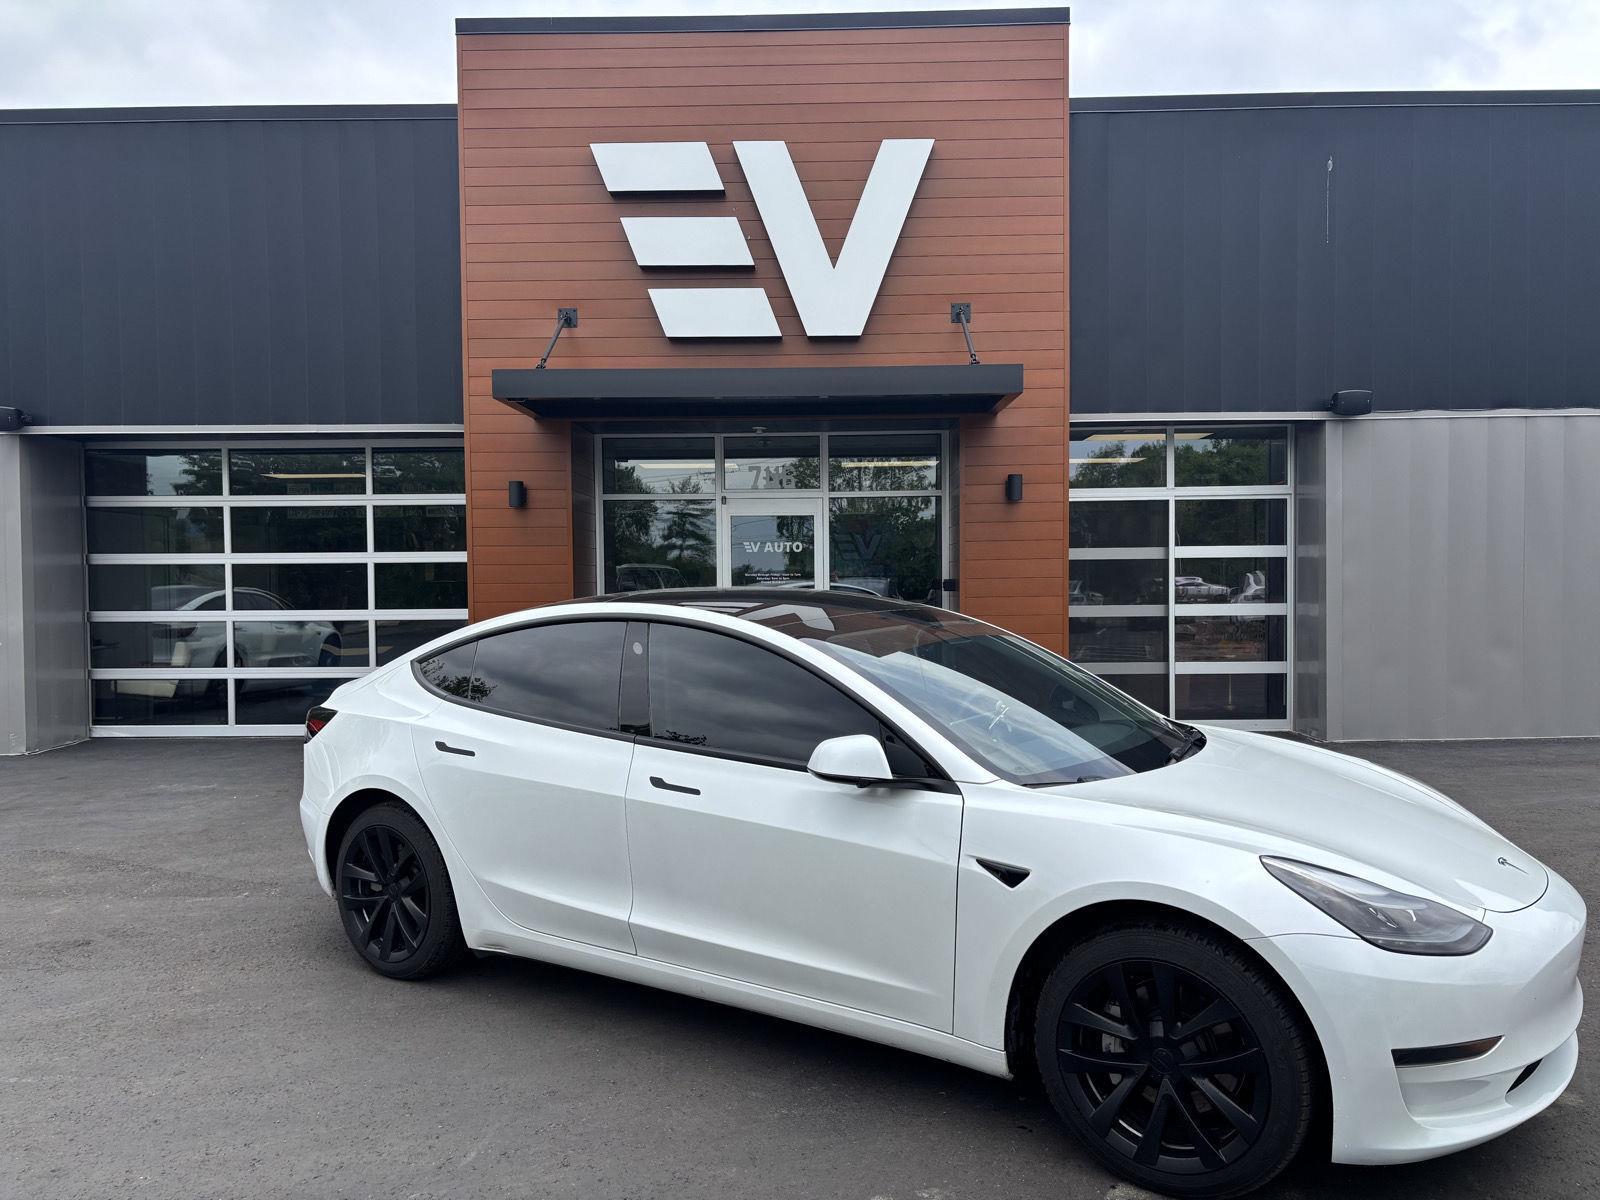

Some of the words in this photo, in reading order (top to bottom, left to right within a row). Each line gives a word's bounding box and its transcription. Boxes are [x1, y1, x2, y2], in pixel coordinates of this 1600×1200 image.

[590, 139, 935, 338] EV
[743, 542, 760, 552] EV
[764, 541, 802, 552] AUTO
